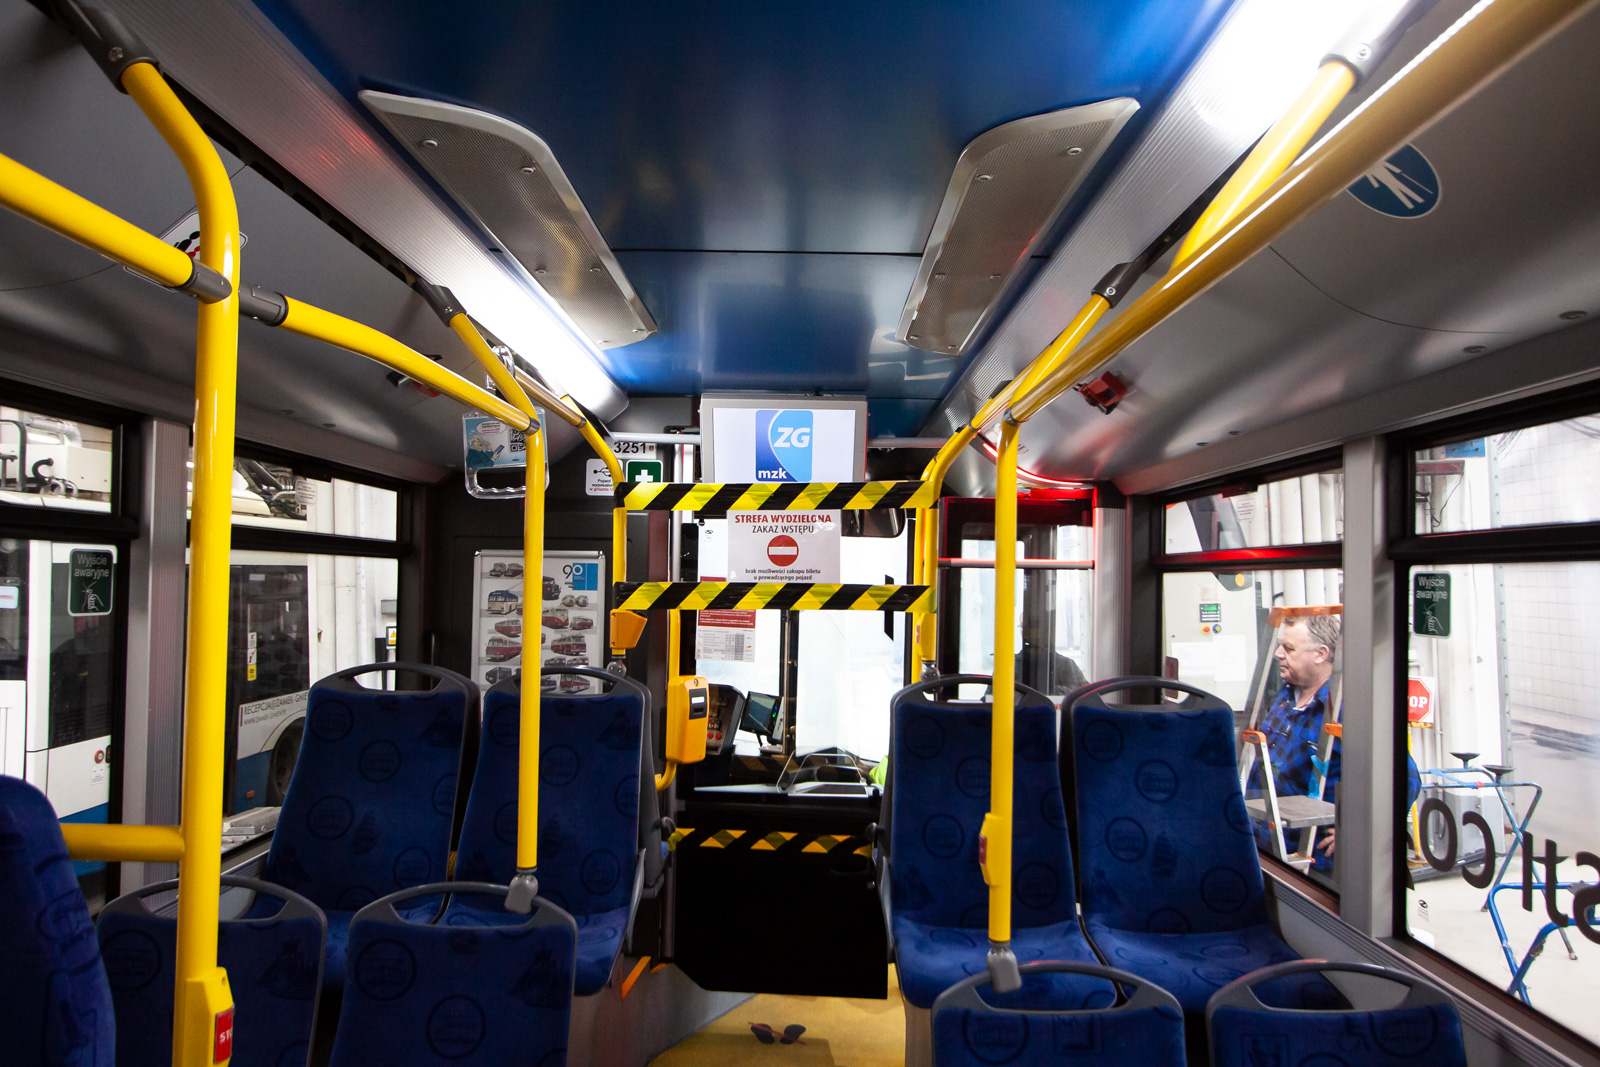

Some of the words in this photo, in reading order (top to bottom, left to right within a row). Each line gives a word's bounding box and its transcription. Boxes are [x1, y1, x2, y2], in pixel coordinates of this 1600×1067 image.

[773, 427, 811, 448] ZG
[614, 442, 646, 453] 3251
[758, 467, 787, 479] mzk
[735, 514, 768, 523] STREFA
[771, 514, 832, 523] WYDZIELONA
[752, 525, 778, 533] ZAKAZ
[781, 525, 814, 535] WSTĘPU
[76, 553, 108, 567] Wyjście
[74, 568, 110, 580] awaryjne
[562, 564, 583, 580] 90
[1418, 576, 1446, 590] Wyjście
[1416, 590, 1448, 602] awaryjne
[1409, 695, 1429, 709] OP
